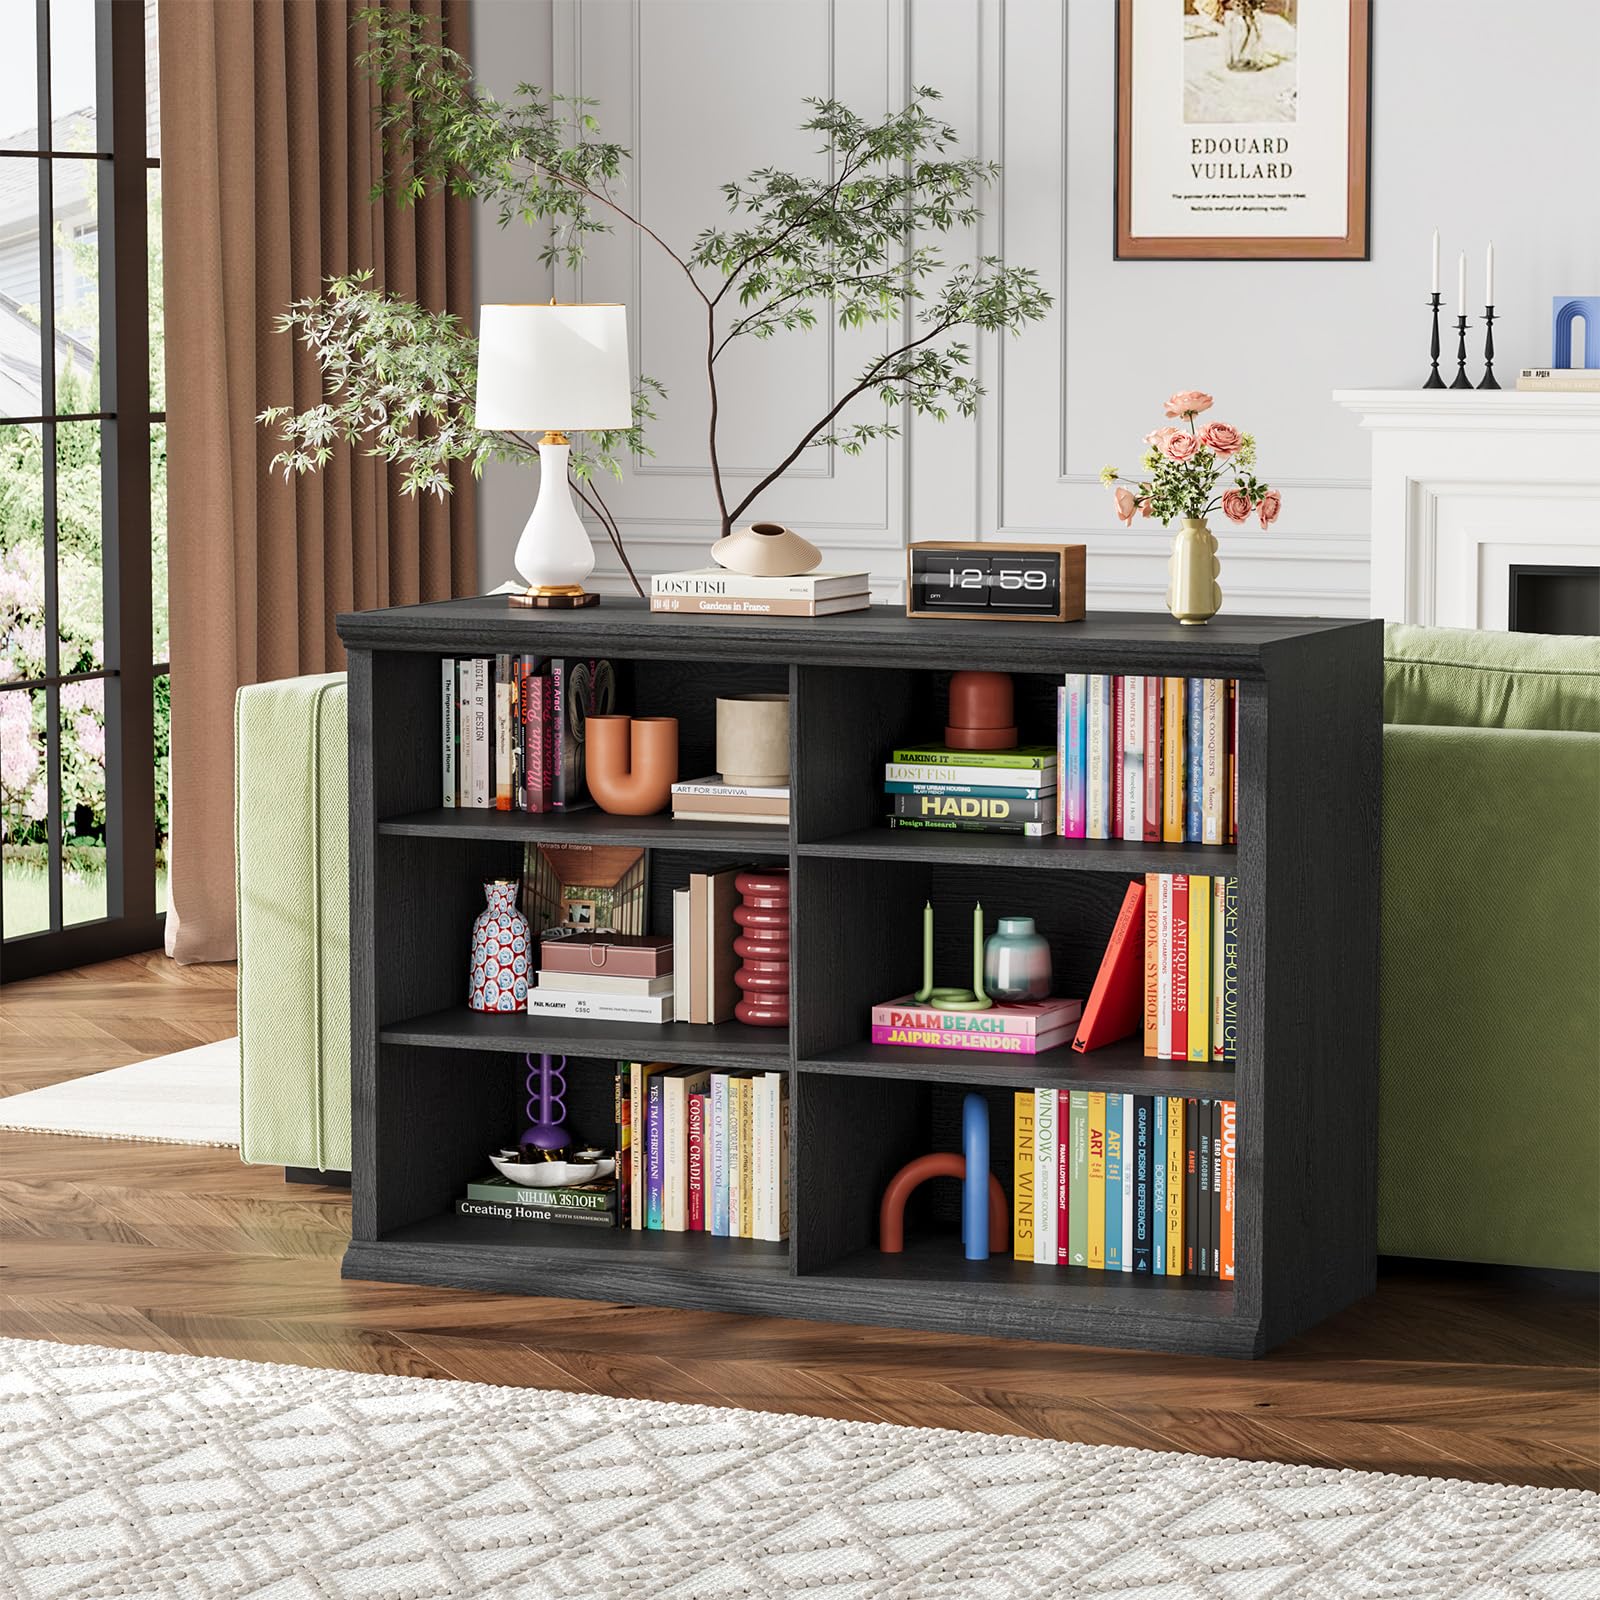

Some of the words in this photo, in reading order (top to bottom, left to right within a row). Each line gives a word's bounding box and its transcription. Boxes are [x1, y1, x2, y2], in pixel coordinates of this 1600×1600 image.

[1191, 137, 1289, 154] EDOUARD
[1191, 163, 1293, 179] VUILLARD
[656, 579, 692, 594] LOST
[695, 580, 726, 594] FISH
[698, 600, 730, 611] Gardens
[732, 602, 742, 611] in
[744, 602, 771, 613] France
[553, 668, 561, 687] Ron
[476, 696, 483, 707] BY
[527, 678, 542, 722] Parr
[553, 689, 561, 711] Arad
[1208, 679, 1217, 721] CONNIE'S
[553, 716, 561, 726] No
[528, 726, 542, 791] Martin
[900, 754, 938, 763] MAKING
[939, 755, 949, 763] IT
[1208, 722, 1217, 777] CONQUESTS
[889, 768, 924, 779] LOST
[927, 768, 956, 781] FISH
[921, 796, 1010, 819] HADID
[1208, 786, 1217, 810] Moore
[899, 819, 924, 827] Design
[925, 821, 957, 829] Research
[1226, 877, 1238, 937] ALEXEY
[1147, 910, 1158, 948] BOOK
[1176, 918, 1187, 1012] ANTIQUAIRES
[1147, 963, 1158, 1031] SYMBOLS
[890, 1012, 941, 1028] PALM
[943, 1015, 1005, 1032] BEACH
[888, 1030, 941, 1045] JAIPUR
[942, 1035, 1021, 1051] SPLENDOR
[650, 1085, 658, 1104] YES,
[730, 1087, 738, 1099] FIRE
[650, 1105, 658, 1119] I'M
[690, 1099, 700, 1143] COSMIC
[715, 1115, 722, 1127] OF
[730, 1117, 738, 1151] CORPORATE
[1039, 1089, 1052, 1162] WINDOWS
[1138, 1107, 1146, 1146] GRAPHIC
[1223, 1103, 1236, 1158] 1000
[1018, 1116, 1033, 1162] FINE
[1091, 1128, 1103, 1158] ART
[1108, 1130, 1121, 1160] ART
[650, 1128, 658, 1179] CHRISTIAN!
[730, 1153, 738, 1170] BELLY
[1138, 1148, 1146, 1181] DESIGN
[690, 1146, 700, 1190] CRADLE
[517, 1191, 557, 1204] WITHIN
[559, 1194, 597, 1207] HOUSE
[650, 1187, 658, 1212] Moore
[1155, 1164, 1164, 1212] BORDEAUX
[461, 1202, 513, 1219] Creating
[515, 1206, 551, 1220] Home
[1018, 1171, 1033, 1239] WINES
[1138, 1183, 1146, 1240] REFERENCED
[1170, 1194, 1178, 1231] Top
